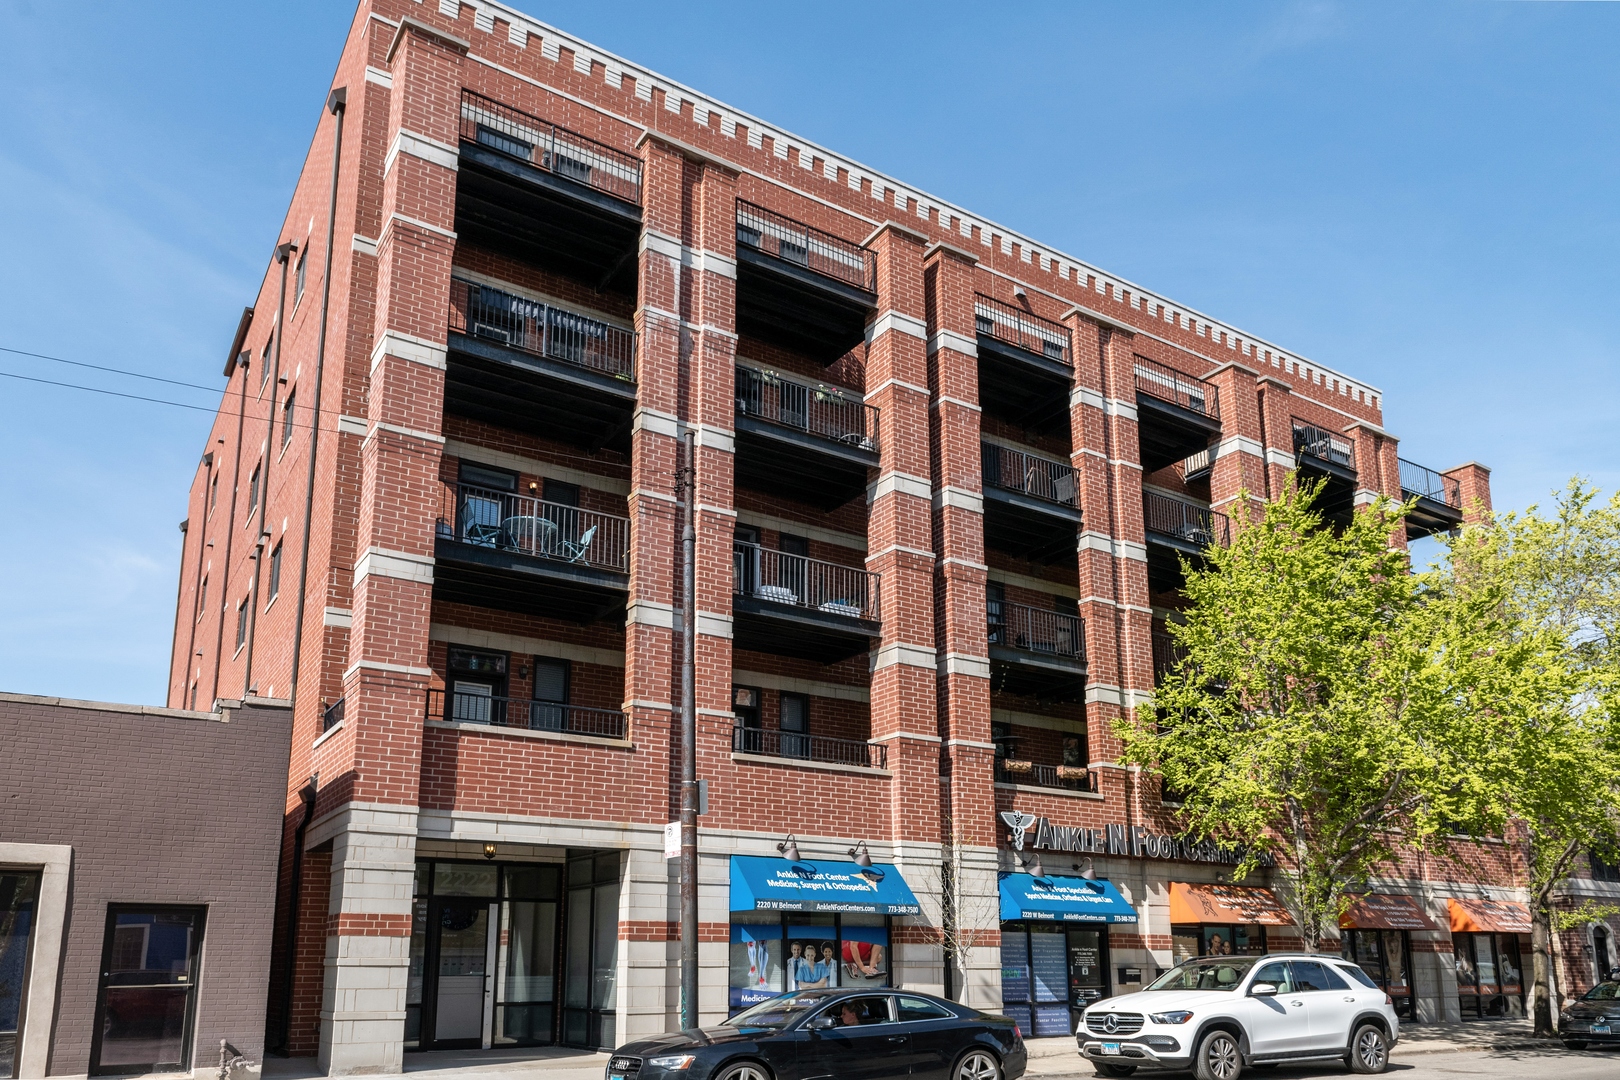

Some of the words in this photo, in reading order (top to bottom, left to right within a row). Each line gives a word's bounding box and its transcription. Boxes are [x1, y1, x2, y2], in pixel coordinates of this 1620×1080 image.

[1033, 817, 1104, 854] ANKLE
[1105, 823, 1128, 855] N
[1129, 825, 1180, 859] FOOT
[440, 872, 491, 888] 2222
[776, 870, 799, 879] Ankle
[798, 872, 806, 880] N
[806, 872, 824, 881] Foot
[824, 873, 850, 882] Center
[766, 879, 801, 890] Medicine,
[801, 881, 826, 892] Surgery
[826, 882, 834, 890] &
[834, 882, 871, 892] Orthopedics
[756, 900, 772, 909] 2220
[779, 902, 802, 910] Belmont
[816, 903, 876, 912] AnkleNFootCenters.com
